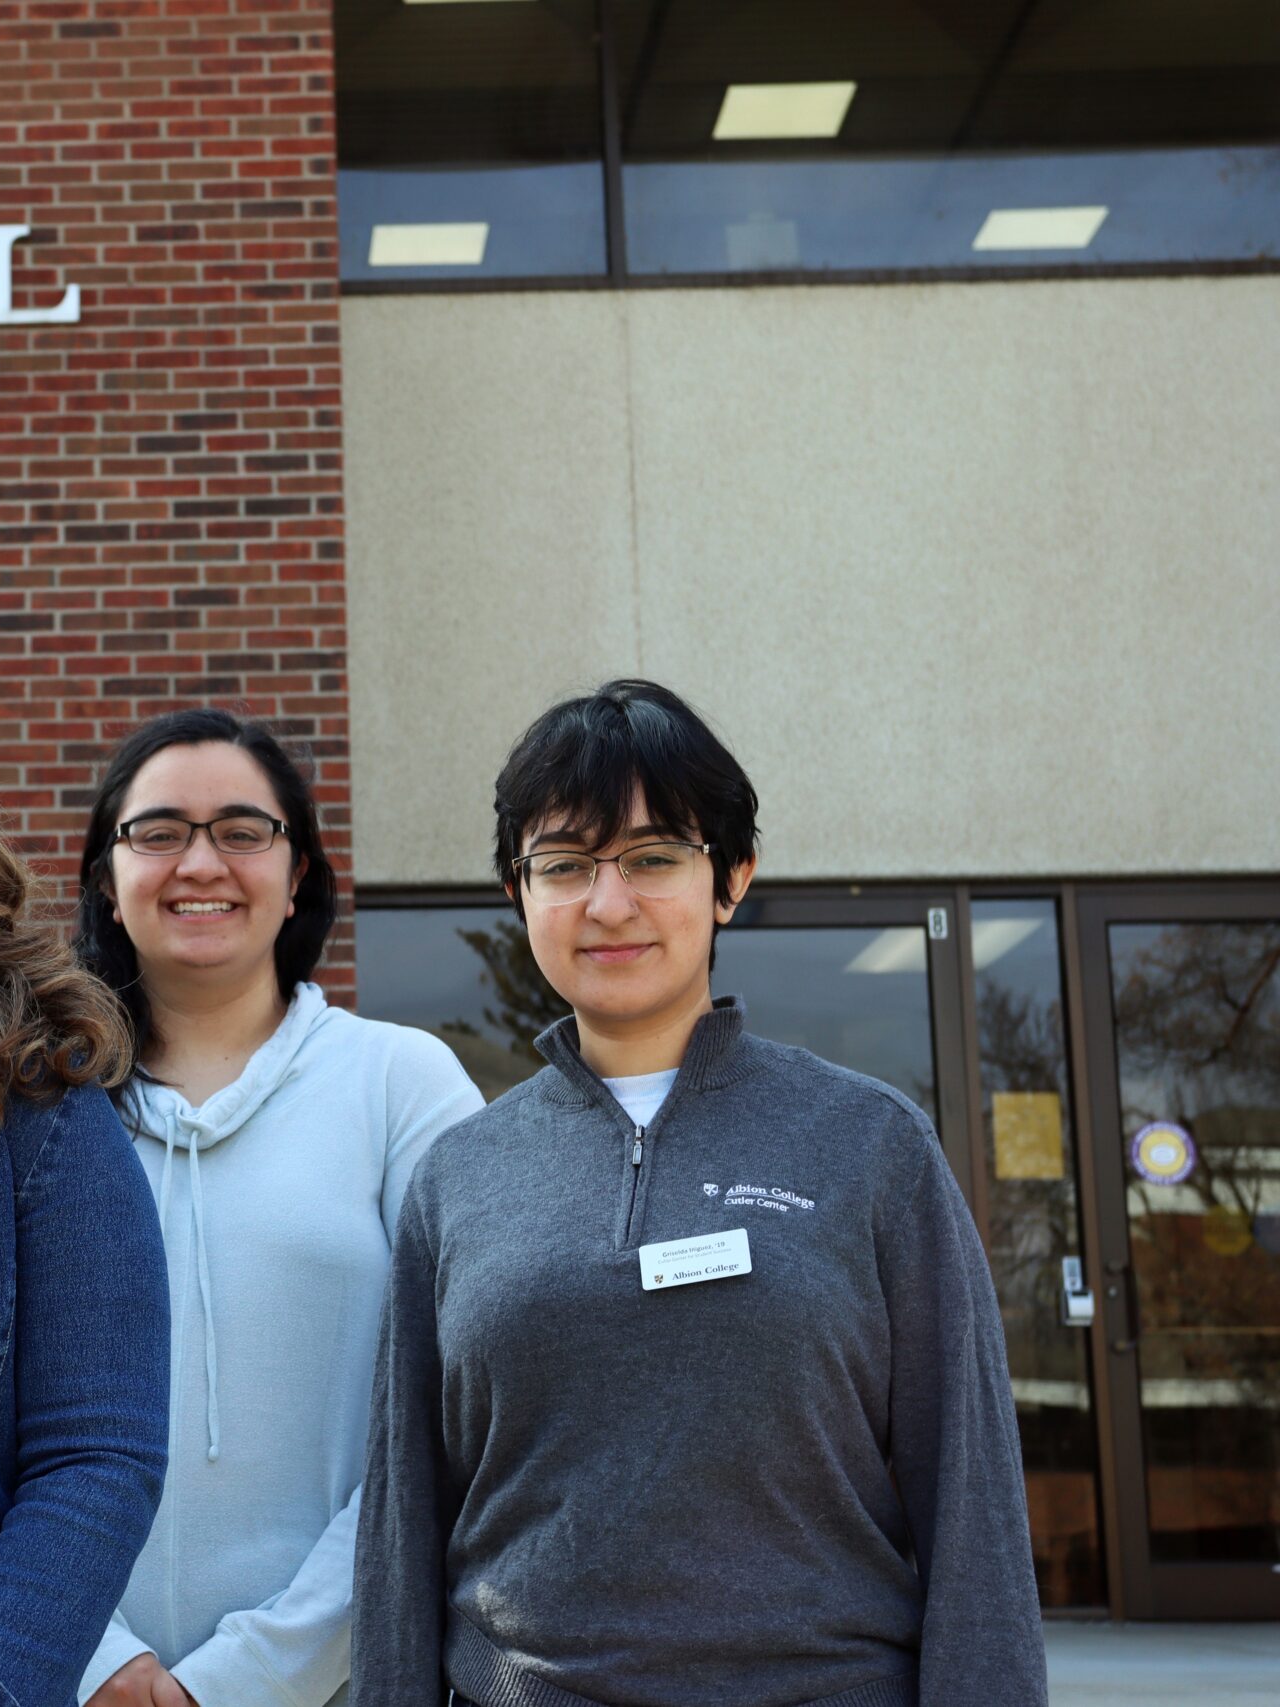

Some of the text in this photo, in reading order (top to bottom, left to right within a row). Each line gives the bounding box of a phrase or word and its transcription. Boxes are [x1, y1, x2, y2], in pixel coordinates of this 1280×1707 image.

[724, 1196, 790, 1212] Cutler Center
[726, 1184, 815, 1209] Albion College
[672, 1263, 740, 1281] Albion College
